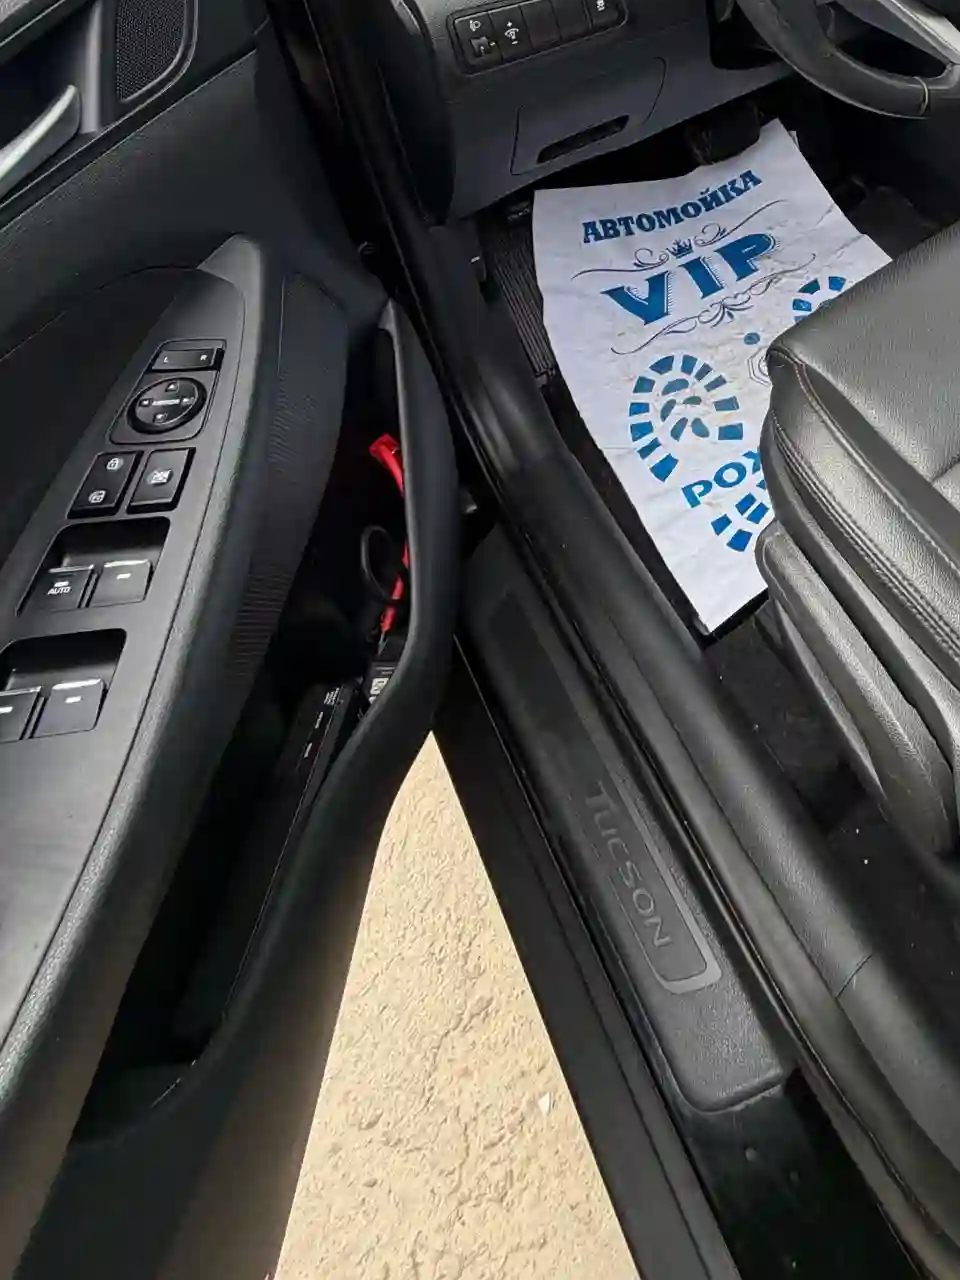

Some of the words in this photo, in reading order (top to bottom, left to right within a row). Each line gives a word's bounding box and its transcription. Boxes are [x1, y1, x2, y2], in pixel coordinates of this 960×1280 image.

[582, 170, 762, 244] АВТОМОЙКА
[600, 232, 781, 326] VIP
[48, 586, 71, 595] AUTO
[586, 781, 673, 947] TUCSON
